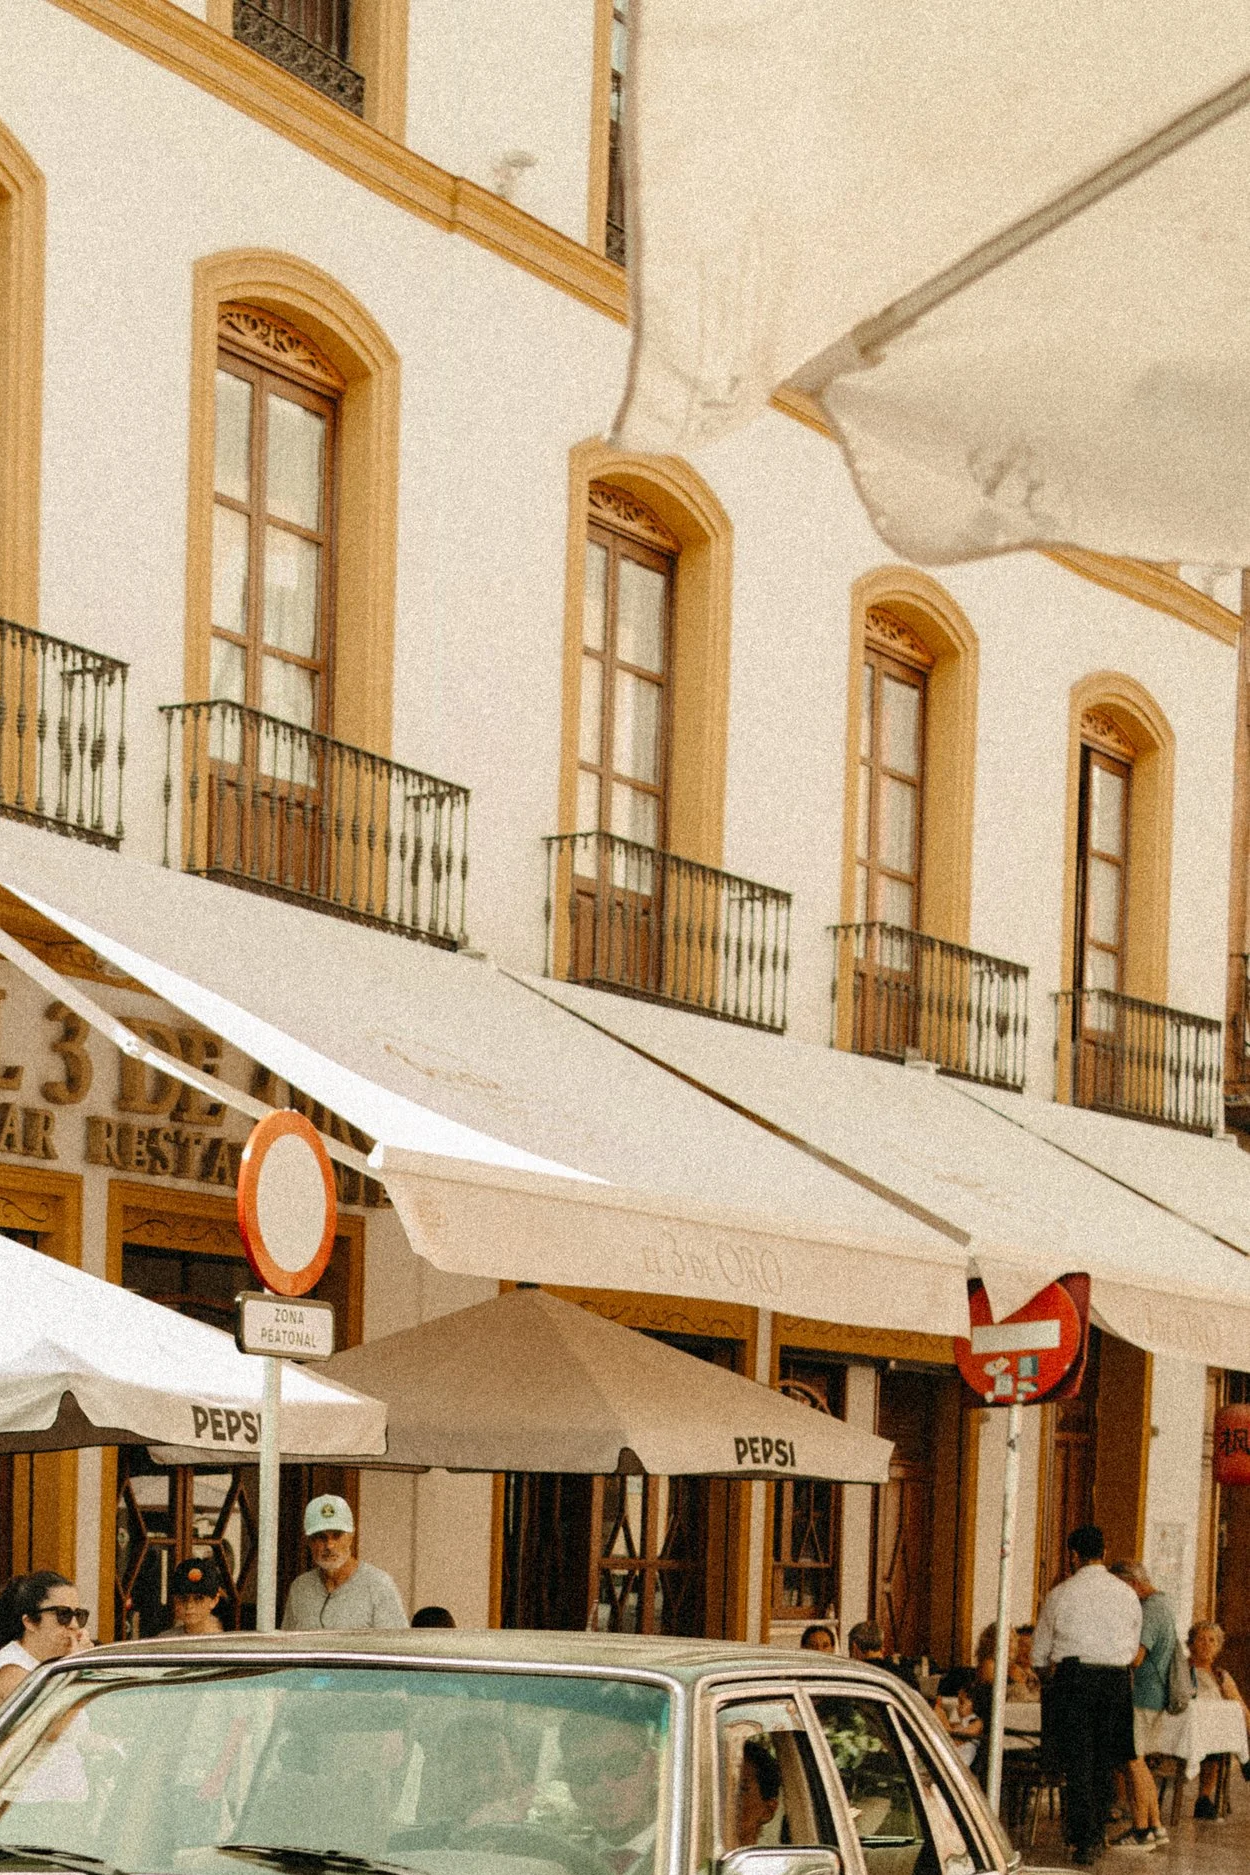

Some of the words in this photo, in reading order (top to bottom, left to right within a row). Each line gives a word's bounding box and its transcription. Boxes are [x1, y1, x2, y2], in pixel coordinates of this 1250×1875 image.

[40, 1000, 93, 1105] 3
[116, 1014, 228, 1127] DE
[275, 1308, 305, 1326] ZONA
[260, 1327, 317, 1349] PEATONAL
[734, 1436, 796, 1468] PEPSI
